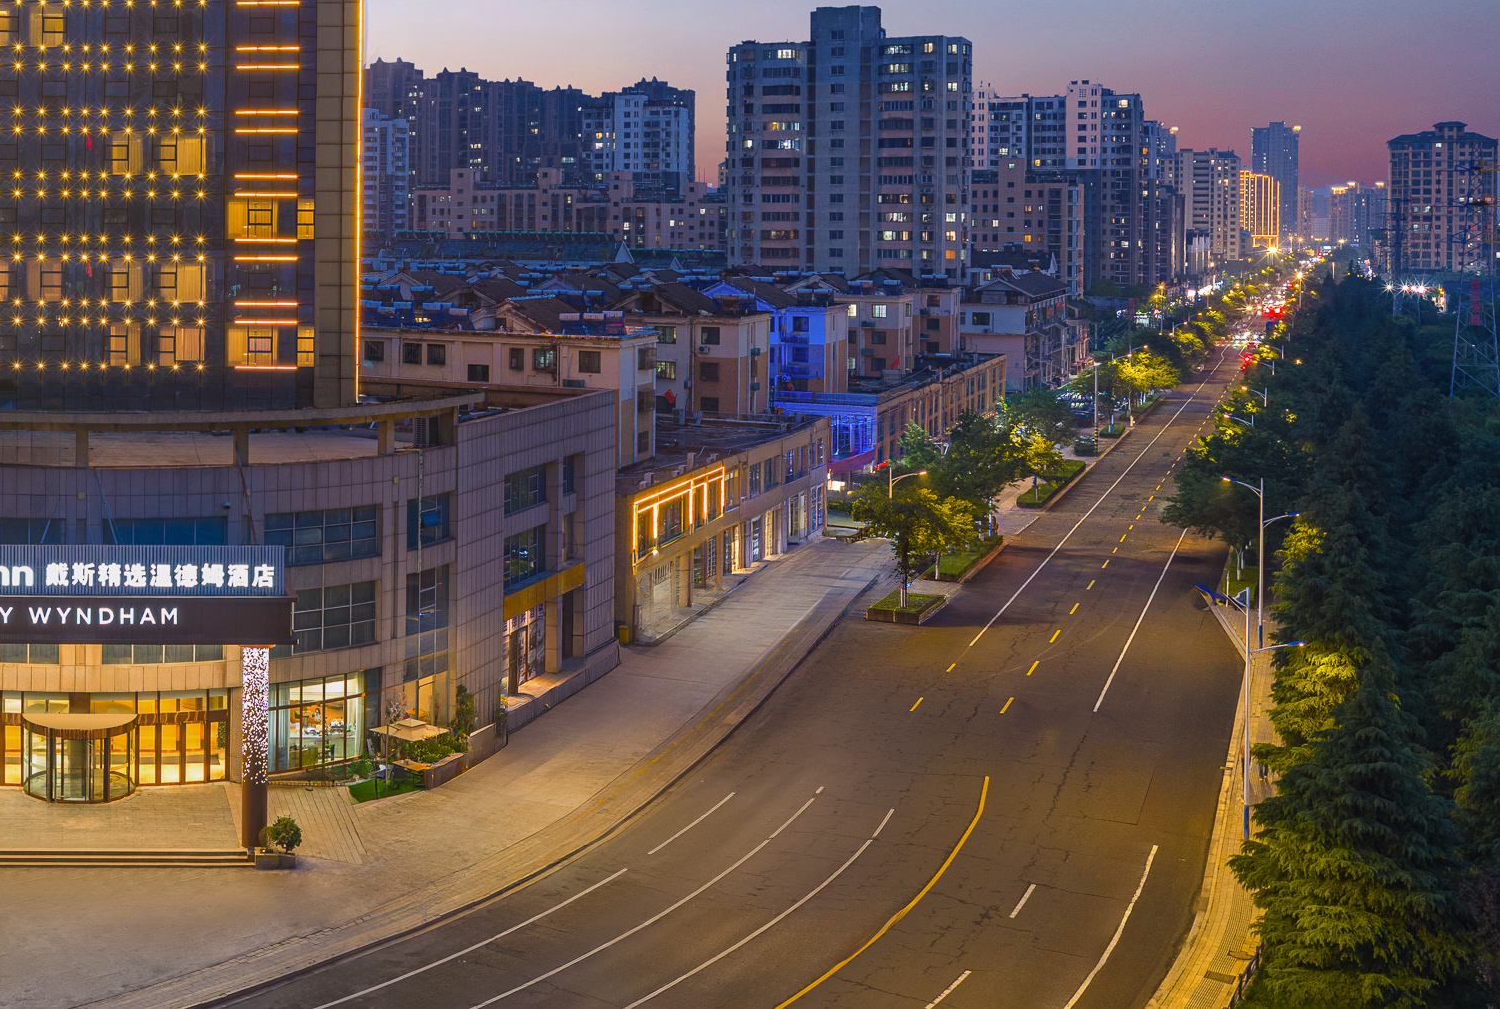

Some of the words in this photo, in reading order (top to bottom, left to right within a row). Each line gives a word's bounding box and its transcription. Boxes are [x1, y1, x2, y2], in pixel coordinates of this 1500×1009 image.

[45, 562, 275, 588] 戴斯精选温德姆酒店
[28, 607, 178, 625] WYNDHAM
